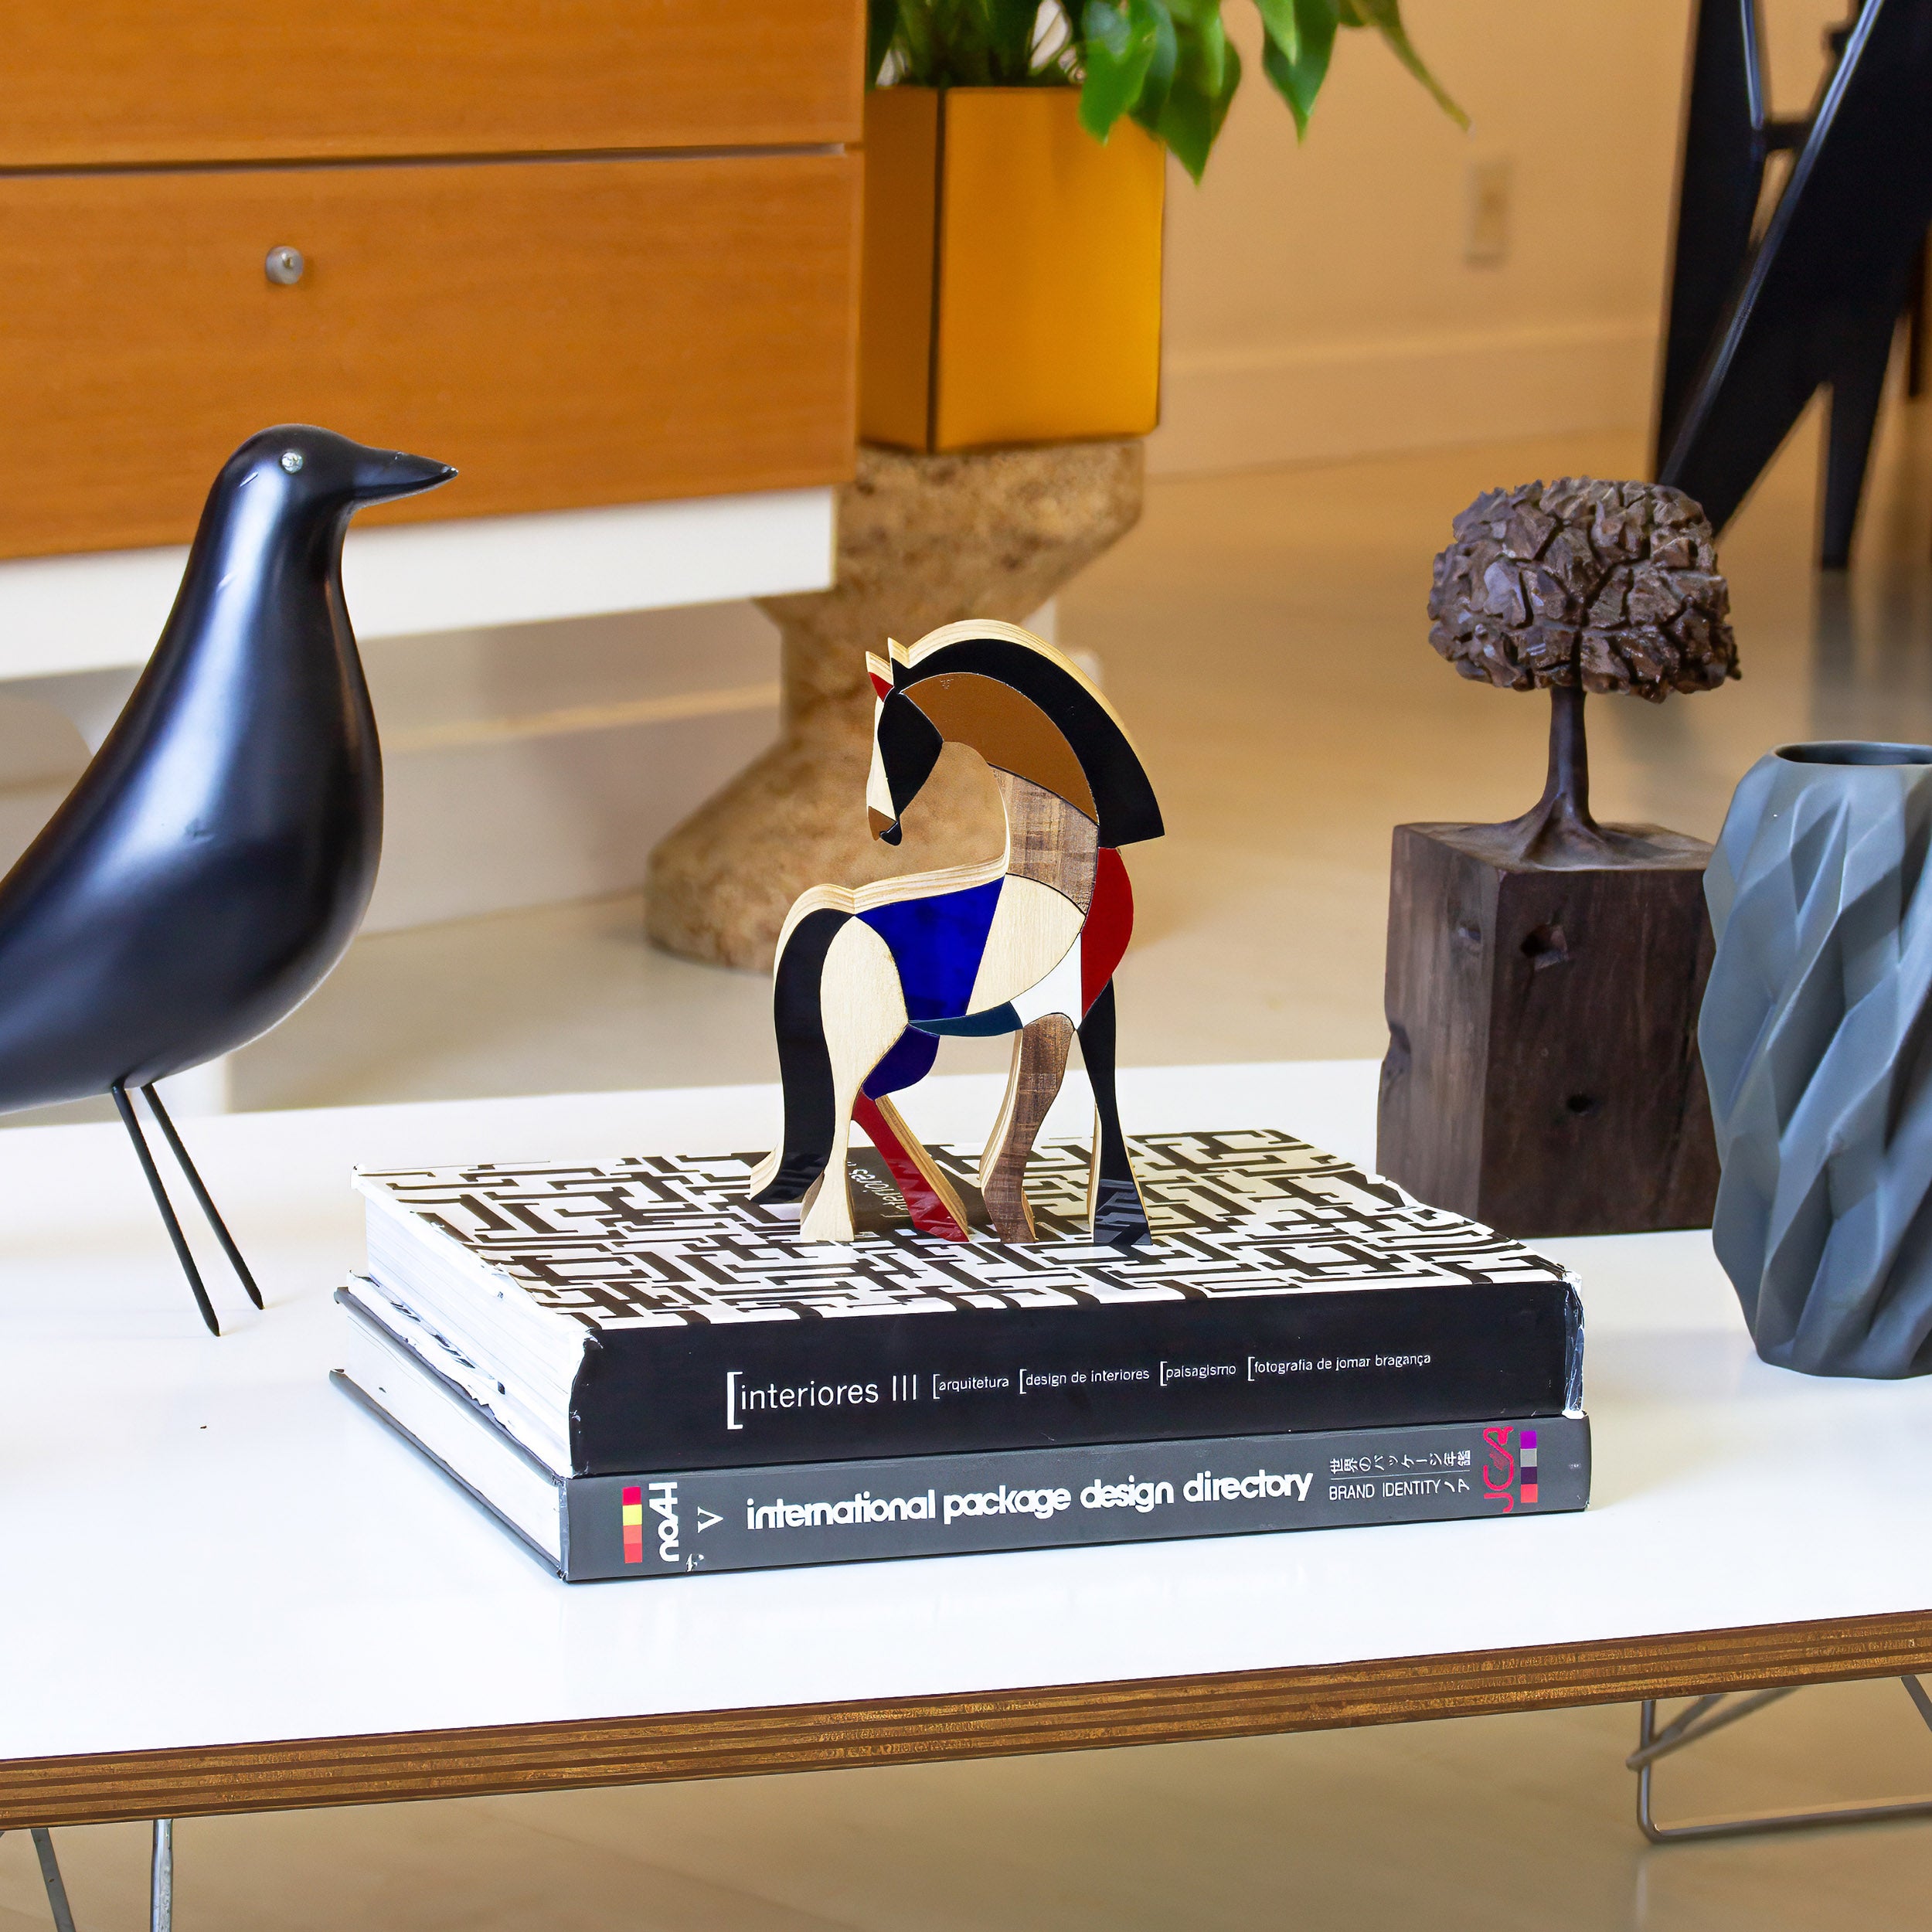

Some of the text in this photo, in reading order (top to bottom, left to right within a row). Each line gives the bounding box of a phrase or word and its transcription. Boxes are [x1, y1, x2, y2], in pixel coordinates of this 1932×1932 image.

[1071, 1372, 1087, 1383] de
[1091, 1369, 1149, 1383] interiores
[1317, 1358, 1332, 1369] de
[1335, 1358, 1371, 1371] jomar
[1376, 1355, 1431, 1368] bragança
[747, 1469, 1313, 1529] international package design directory
[1329, 1479, 1441, 1500] BRAND IDENTITY
